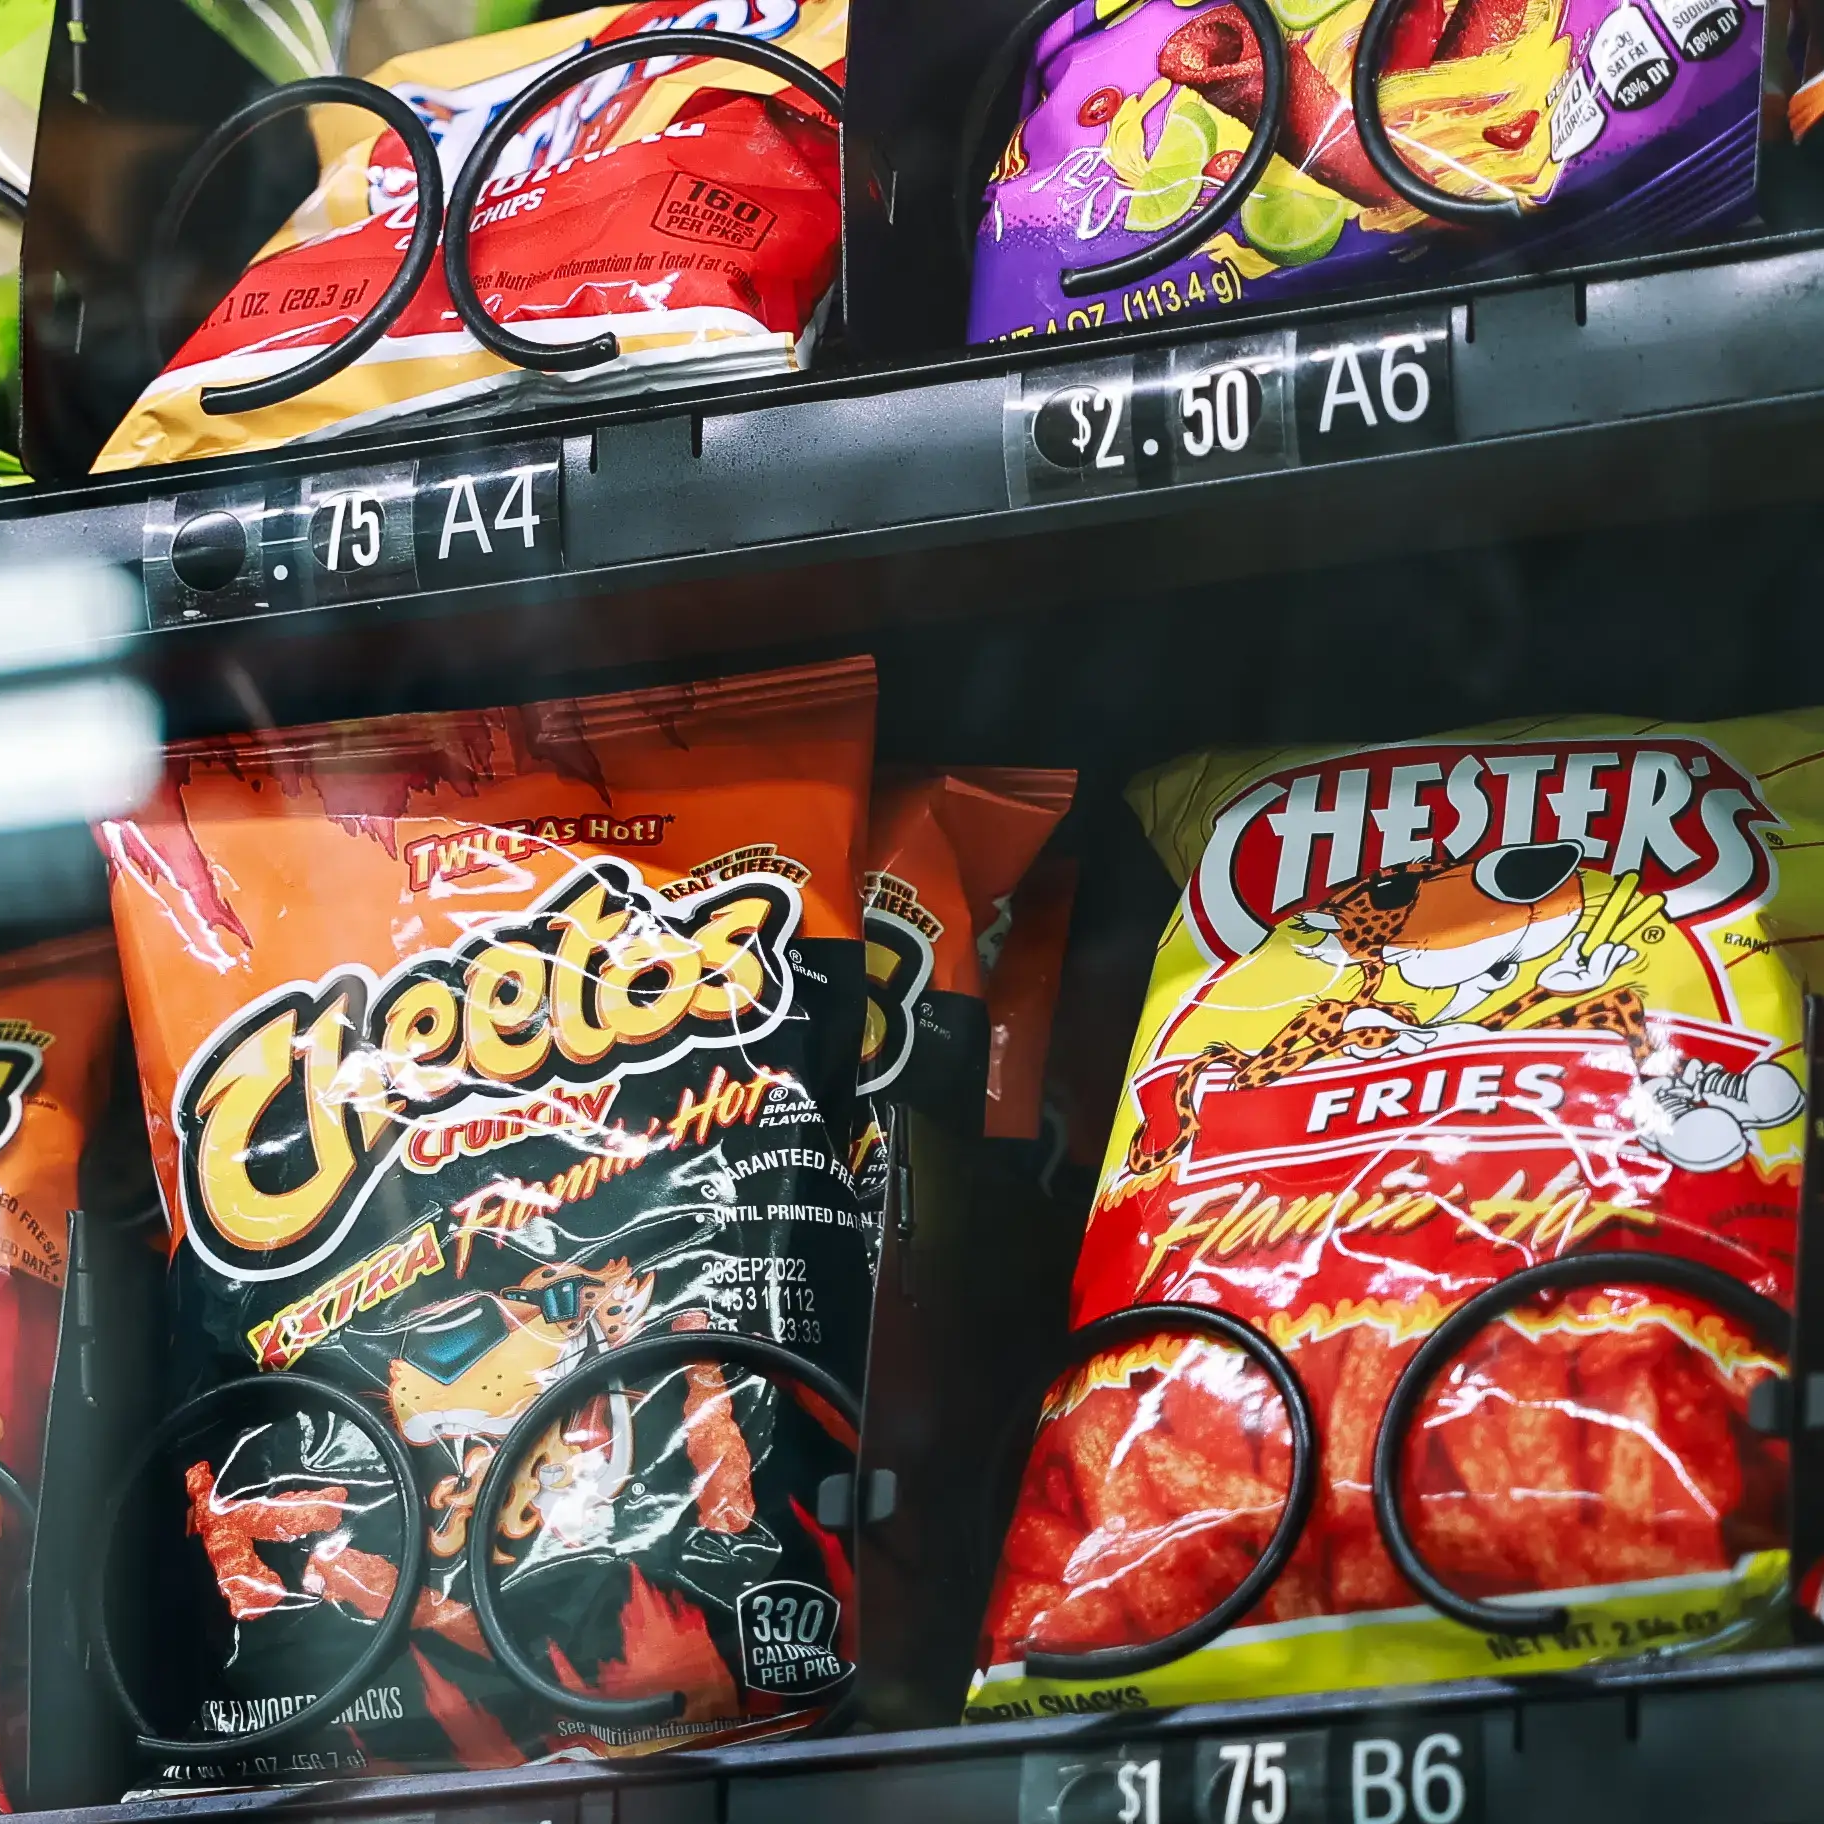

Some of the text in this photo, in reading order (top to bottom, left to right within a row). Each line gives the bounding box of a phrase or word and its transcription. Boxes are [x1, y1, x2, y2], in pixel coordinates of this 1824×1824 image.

[1686, 9, 1739, 58] 18% DV
[1606, 58, 1628, 78] SAT
[1630, 40, 1650, 63] FAT
[1617, 59, 1671, 107] 13% DV
[468, 187, 547, 233] CHIPS
[667, 201, 757, 239] CALORIES
[687, 178, 762, 223] 160
[665, 216, 744, 245] PER PKG
[554, 252, 722, 279] Information for Total Fat
[280, 285, 336, 312] (28.3
[343, 279, 368, 309] g)
[1124, 260, 1243, 322] (113.4 g)
[1319, 341, 1429, 433] A6
[437, 473, 541, 560] A4
[690, 845, 774, 879] MADE WITH
[1197, 748, 1785, 940] CHESTER'S
[663, 857, 808, 902] REAL CHEESE!
[1723, 930, 1771, 955] BRAND
[792, 962, 829, 985] BRAND
[193, 884, 771, 1252] Cheetos
[1306, 1062, 1567, 1133] FRIES
[407, 1084, 616, 1167] Crunchy
[700, 1149, 825, 1201] GUARANTEED
[715, 1205, 832, 1223] UNTIL PRINTED
[19, 1211, 64, 1265] FRESH
[22, 1250, 52, 1279] DATE
[752, 1595, 824, 1643] 330
[760, 1656, 841, 1685] PER PKG
[557, 1719, 651, 1746] See Nutrition
